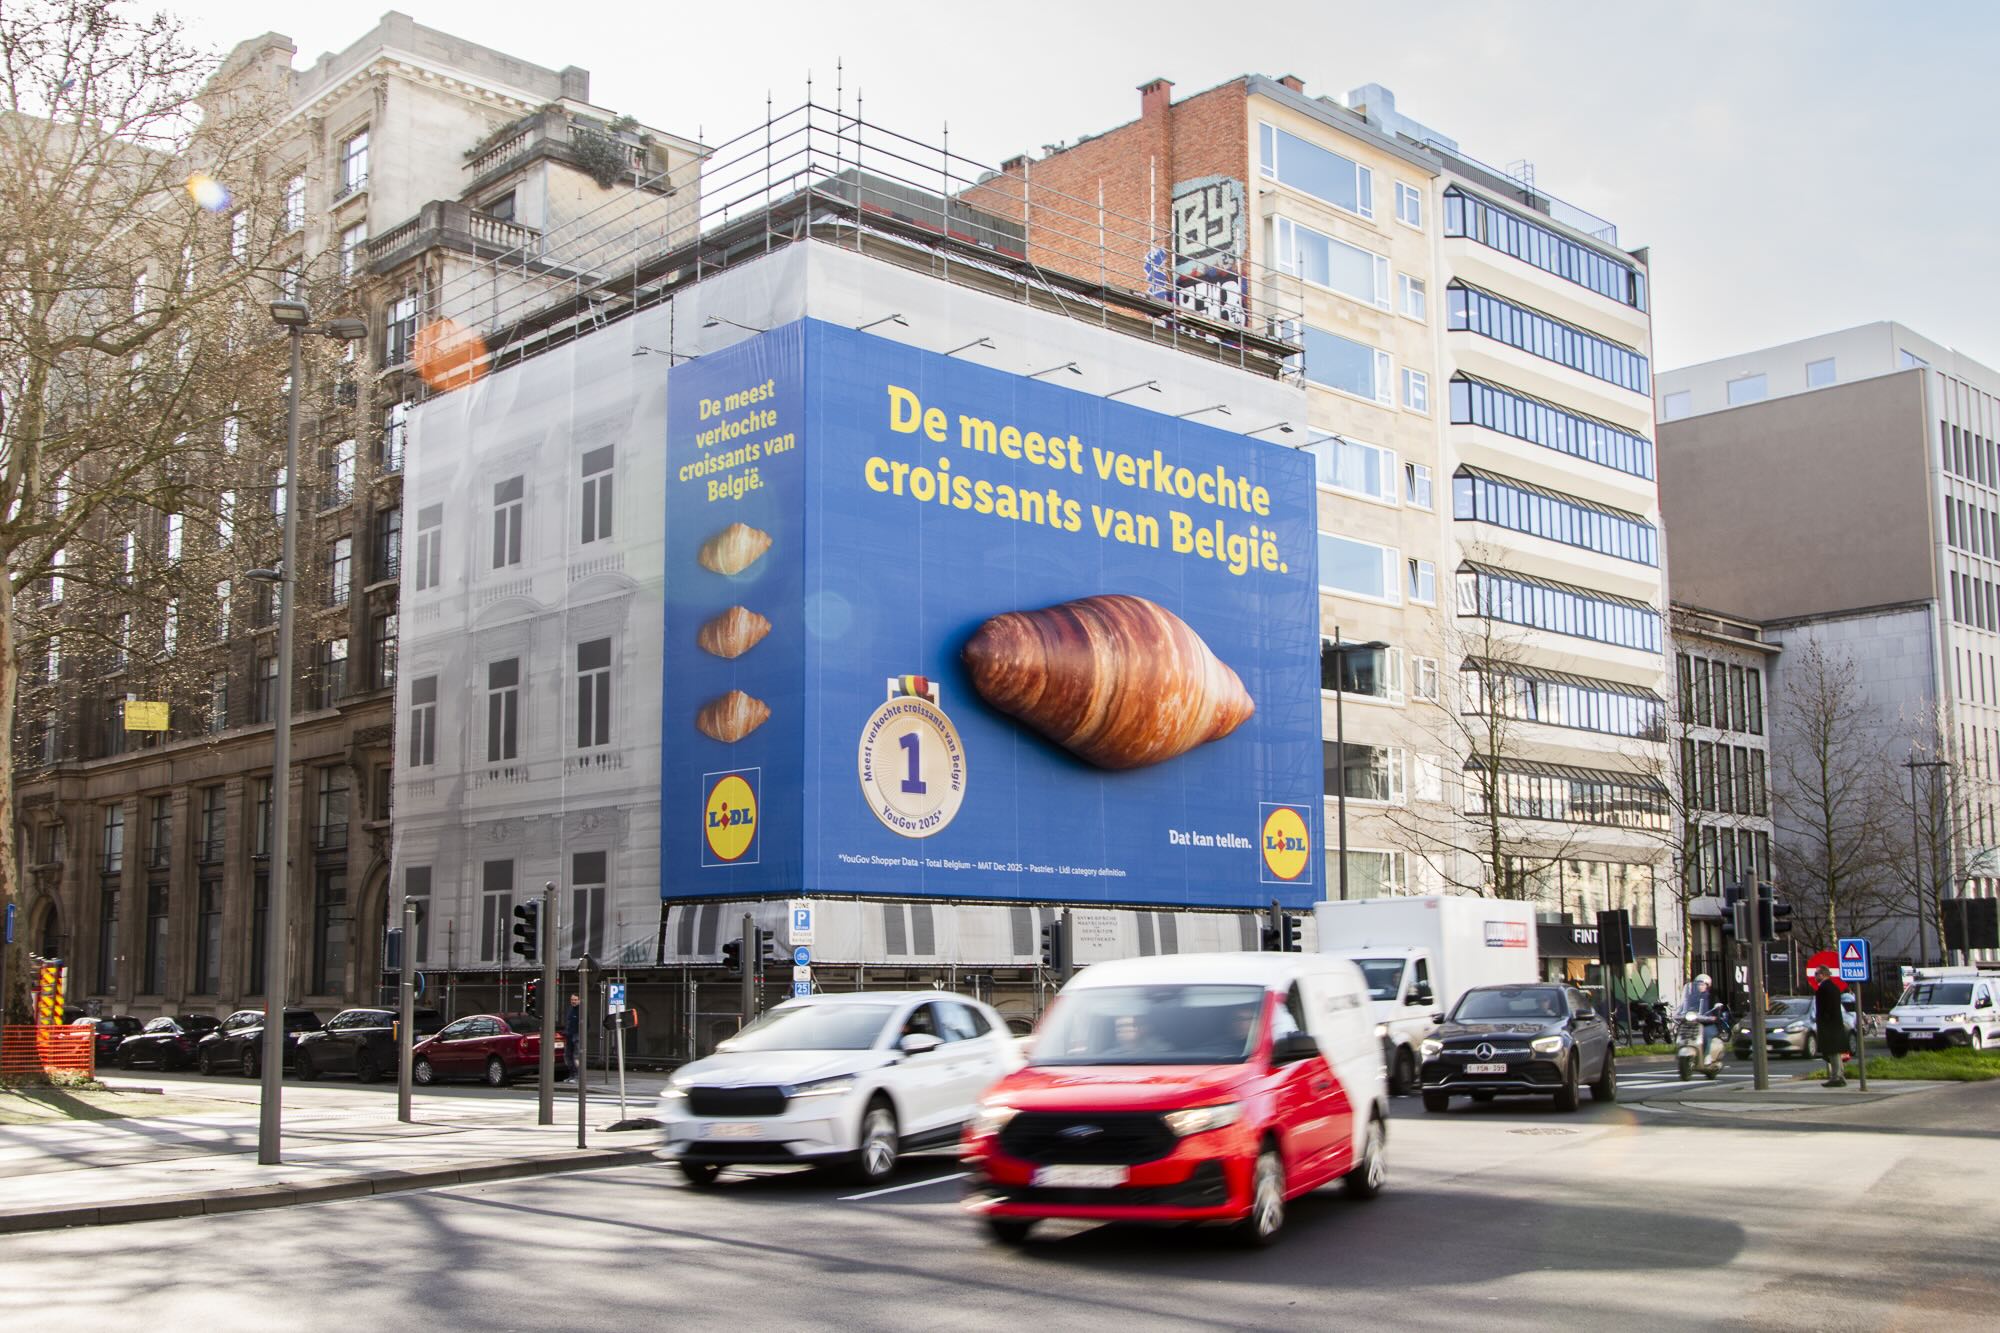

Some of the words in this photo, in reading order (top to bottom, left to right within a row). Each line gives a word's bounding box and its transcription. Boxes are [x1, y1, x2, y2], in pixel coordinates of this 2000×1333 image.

[699, 398, 721, 420] De
[725, 379, 775, 412] meest
[696, 409, 777, 449] verkochte
[679, 443, 760, 482] croissants
[764, 432, 795, 456] van
[887, 384, 948, 442] De
[959, 414, 1084, 475] meest
[1092, 447, 1271, 517] verkochte
[707, 467, 764, 502] België.
[864, 456, 1082, 532] croissants
[1091, 504, 1159, 548] van
[1169, 510, 1288, 576] België.
[867, 705, 902, 744] verkochte
[903, 703, 946, 732] croissants
[945, 732, 956, 753] van
[864, 746, 873, 782] Meest
[899, 732, 927, 794] 1
[952, 754, 960, 792] België
[882, 805, 917, 830] YouGov
[1169, 829, 1191, 845] Dat
[1193, 831, 1214, 847] kan
[1215, 833, 1252, 849] tellen.
[871, 855, 901, 867] Shopper
[902, 857, 919, 867] Data
[925, 858, 942, 868] Total
[944, 860, 971, 870] Belgium
[978, 862, 993, 870] MAT
[993, 862, 1006, 871] Dec
[1007, 863, 1023, 872] 2025
[1030, 864, 1054, 873] Pastries
[1059, 866, 1071, 874] Lidl
[1071, 868, 1098, 877] category
[1098, 868, 1127, 877] definition
[797, 984, 807, 993] 25
[1735, 965, 1748, 984] 67
[1843, 968, 1864, 977] TRAM
